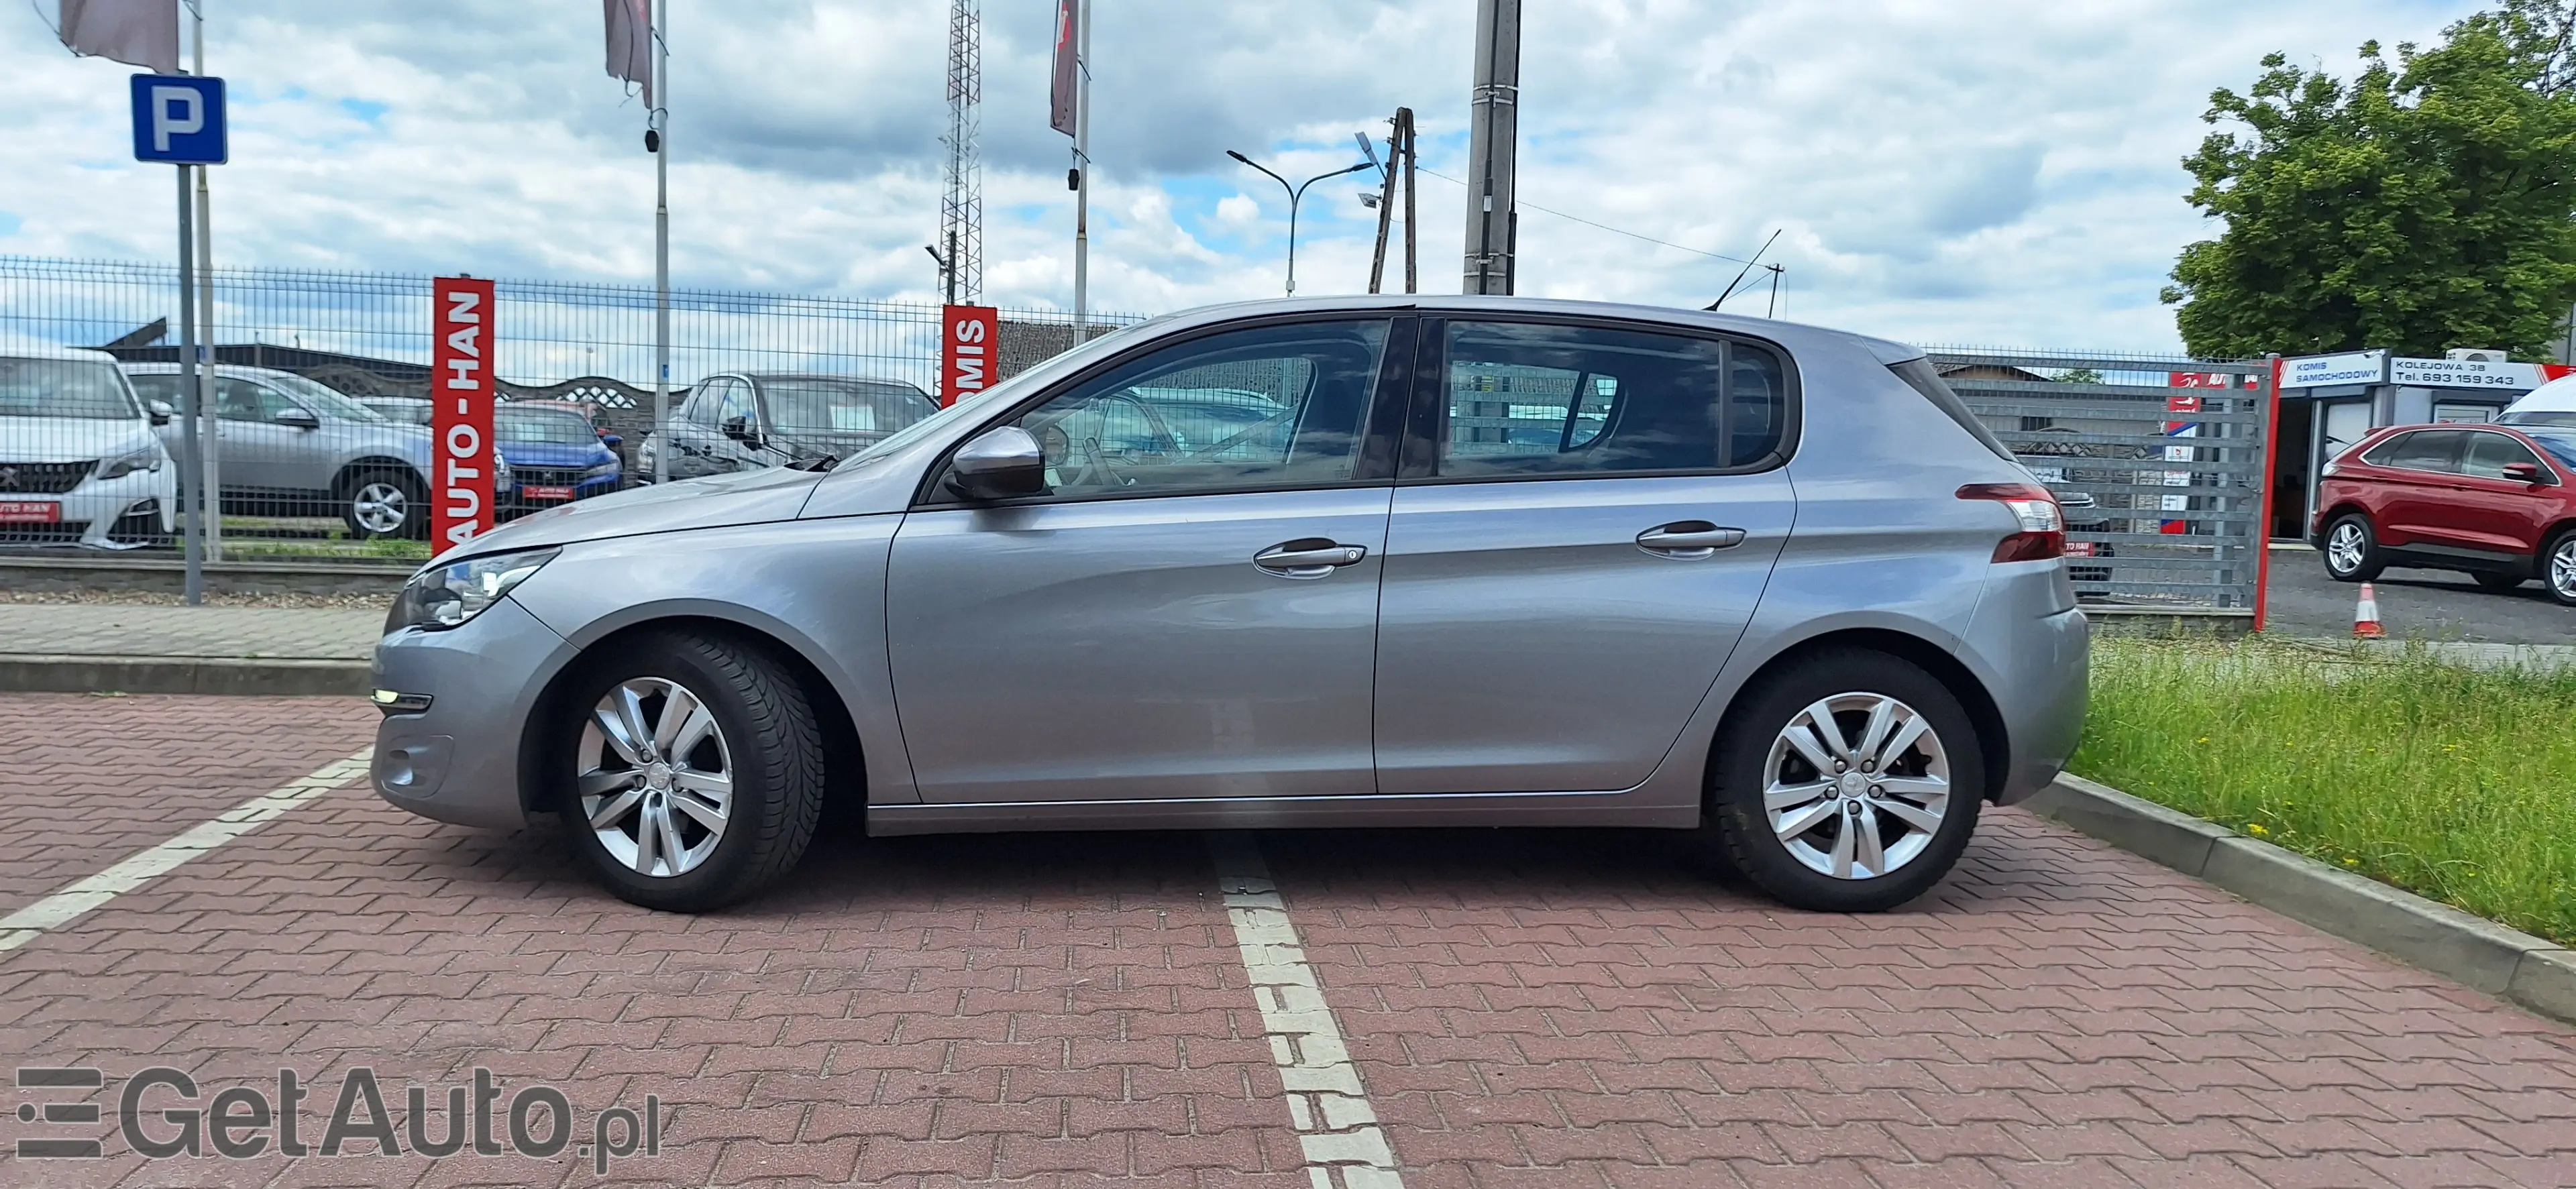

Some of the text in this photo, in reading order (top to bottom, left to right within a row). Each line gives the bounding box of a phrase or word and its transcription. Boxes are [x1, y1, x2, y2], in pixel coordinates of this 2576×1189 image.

[151, 85, 205, 152] P
[955, 319, 985, 404] MIS
[2296, 362, 2327, 372] KOMIS
[2396, 361, 2463, 371] KOLEJOWA
[2296, 370, 2378, 382] SAMOCHODOWY
[2396, 372, 2514, 385] Tel. 693 159 343
